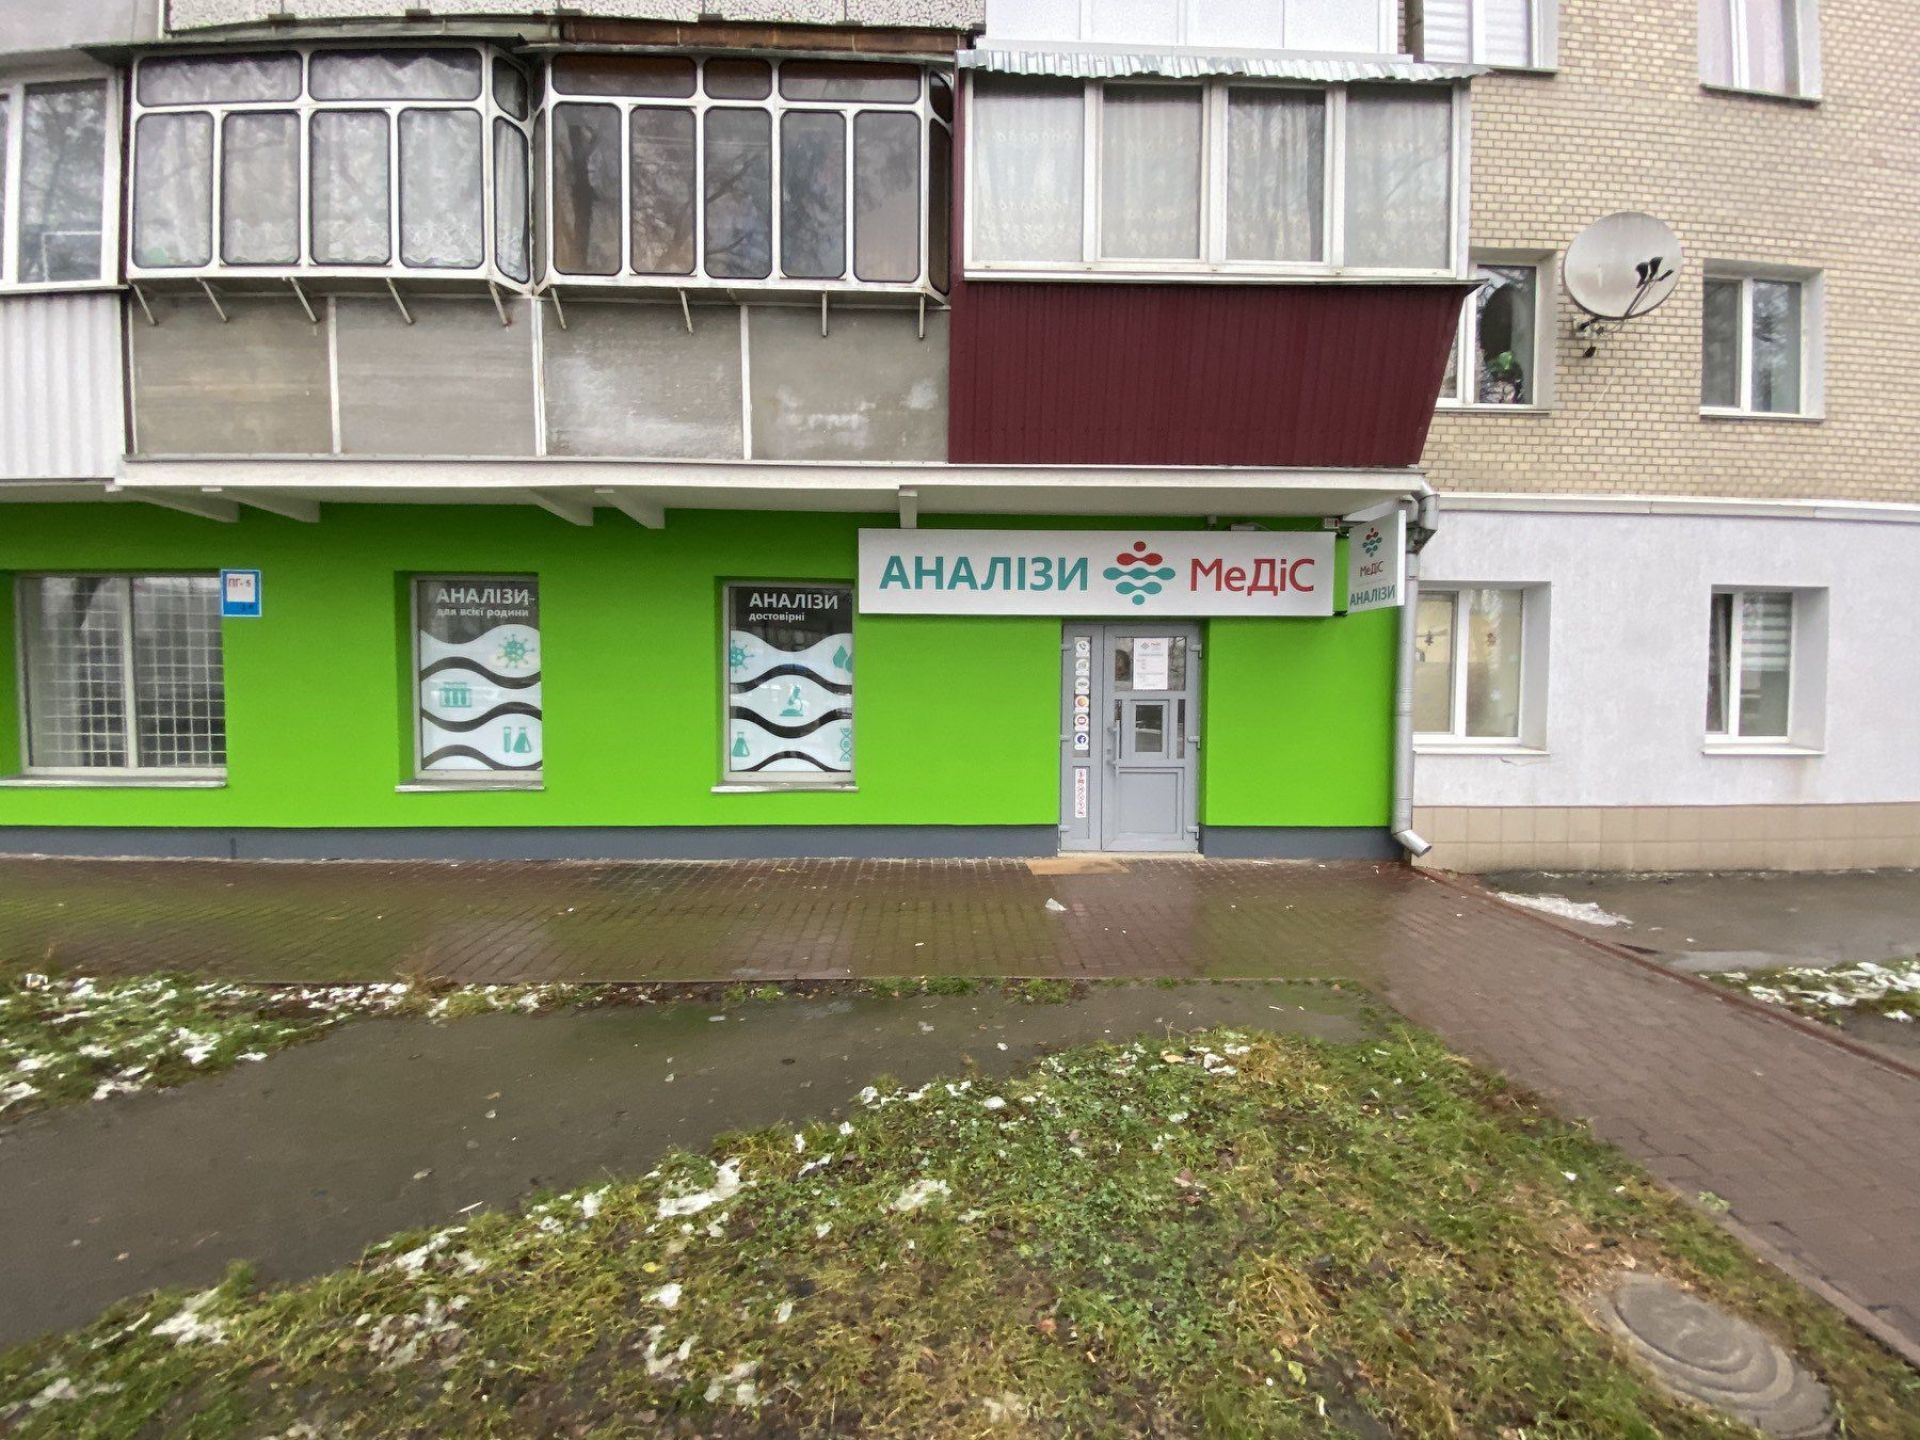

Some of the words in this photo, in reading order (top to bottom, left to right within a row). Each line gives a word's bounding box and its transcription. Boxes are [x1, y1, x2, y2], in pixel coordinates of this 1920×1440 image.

[879, 555, 1088, 591] АНАЛІЗИ
[1190, 558, 1315, 597] МеДіС
[436, 588, 529, 605] АНАЛІЗИ
[749, 592, 839, 610] АНАЛІЗИ
[1349, 584, 1396, 606] АНАЛІЗИ
[486, 608, 529, 619] родини
[748, 611, 806, 623] достовірні
